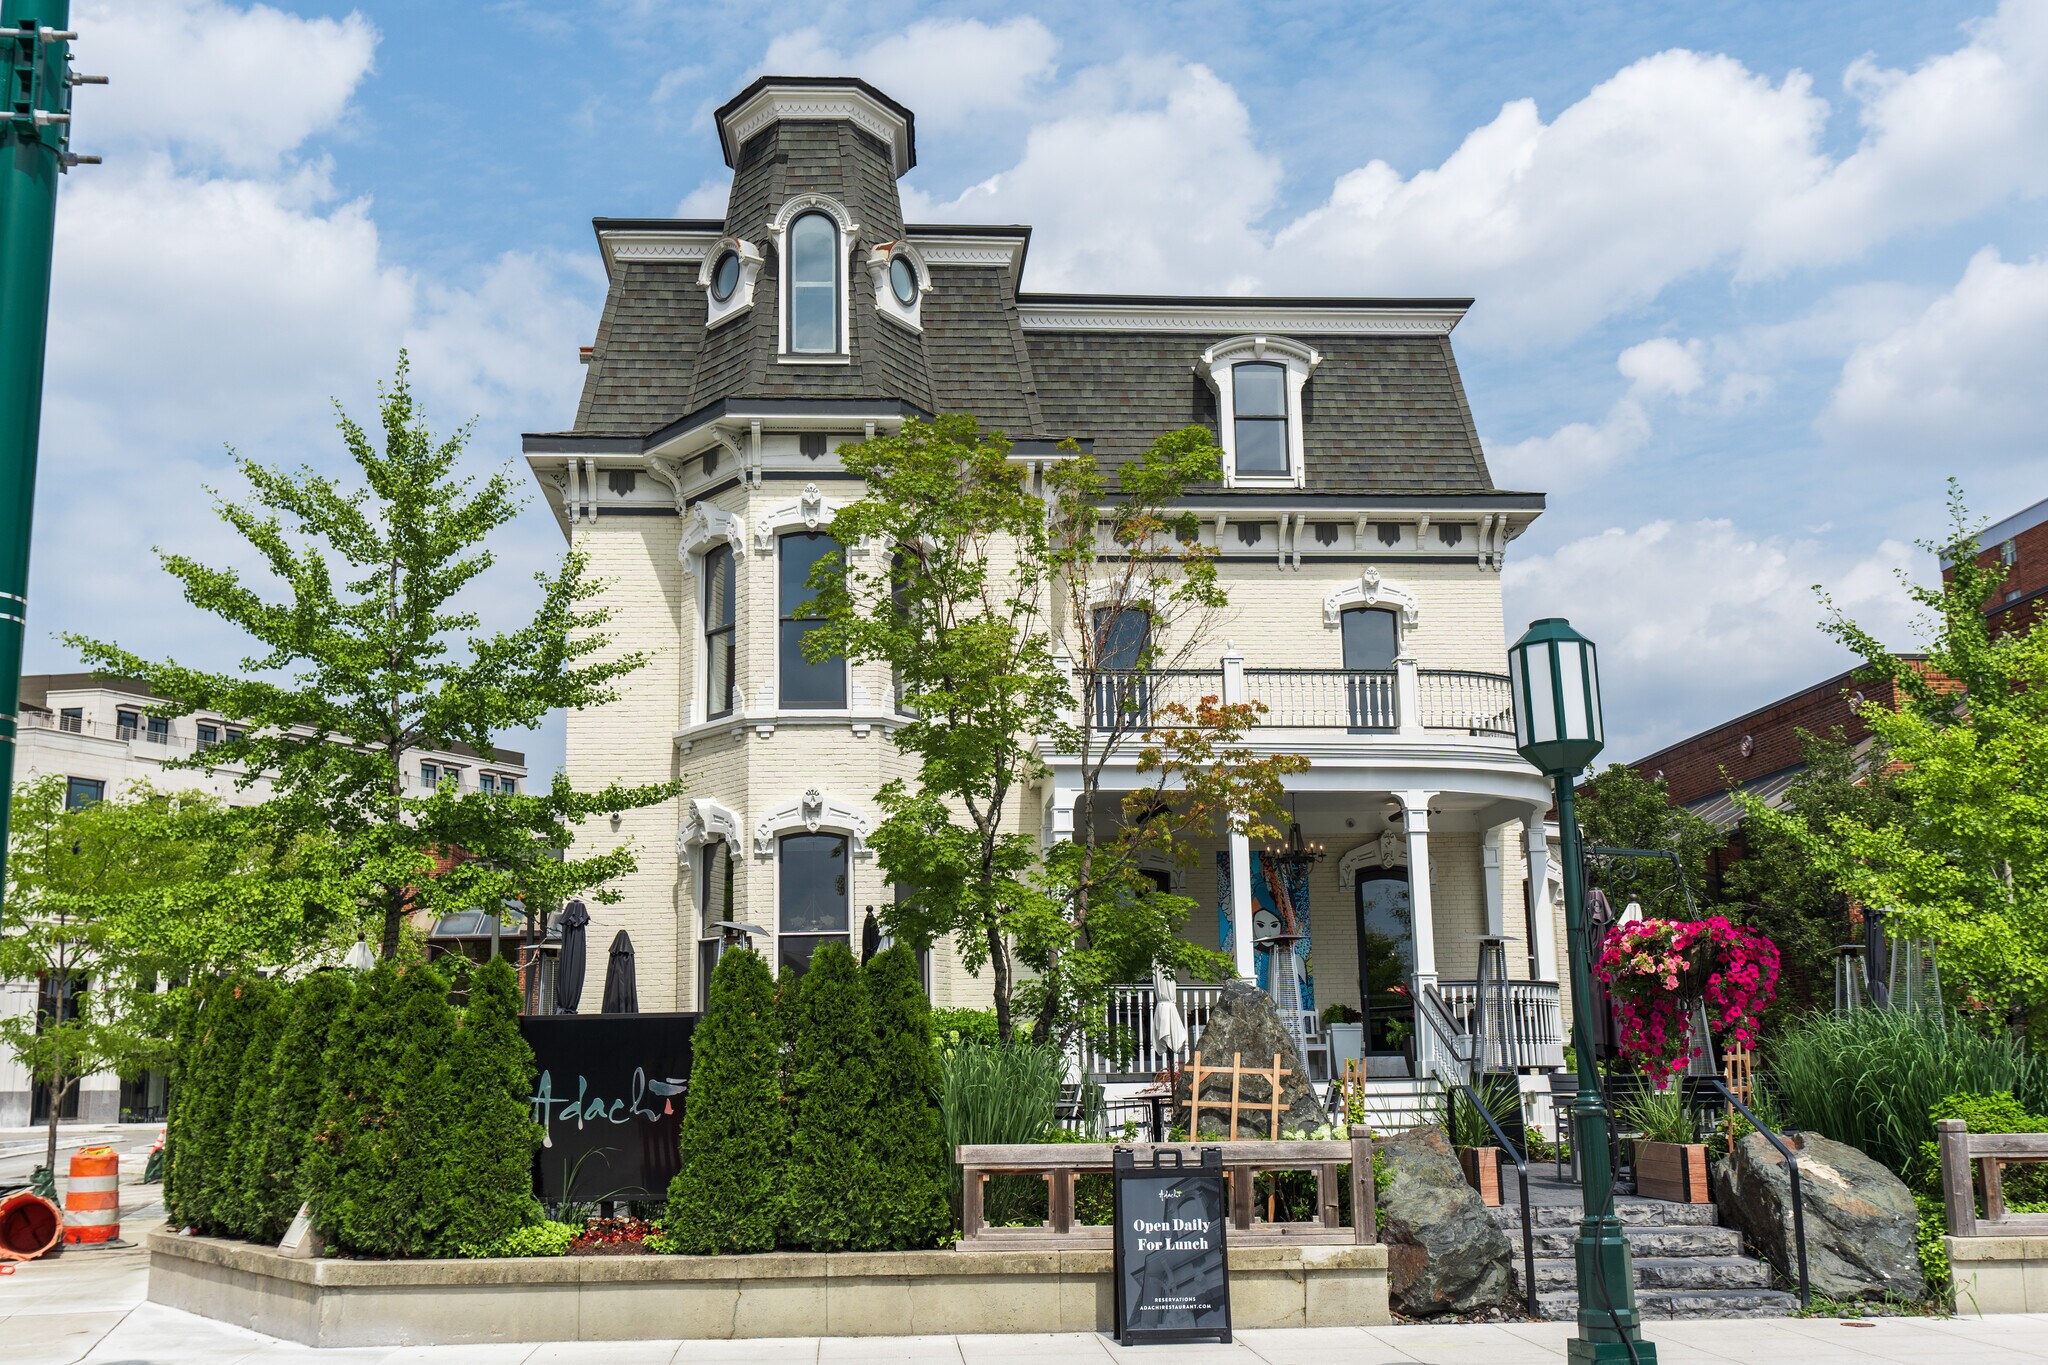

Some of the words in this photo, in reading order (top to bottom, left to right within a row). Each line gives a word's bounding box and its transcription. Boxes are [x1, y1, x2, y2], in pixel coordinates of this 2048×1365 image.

[528, 1066, 688, 1149] Adachi
[1158, 1189, 1183, 1202] Adachi
[1133, 1218, 1170, 1234] Open
[1172, 1218, 1210, 1233] Daily
[1137, 1238, 1163, 1251] For
[1165, 1237, 1209, 1251] Lunch
